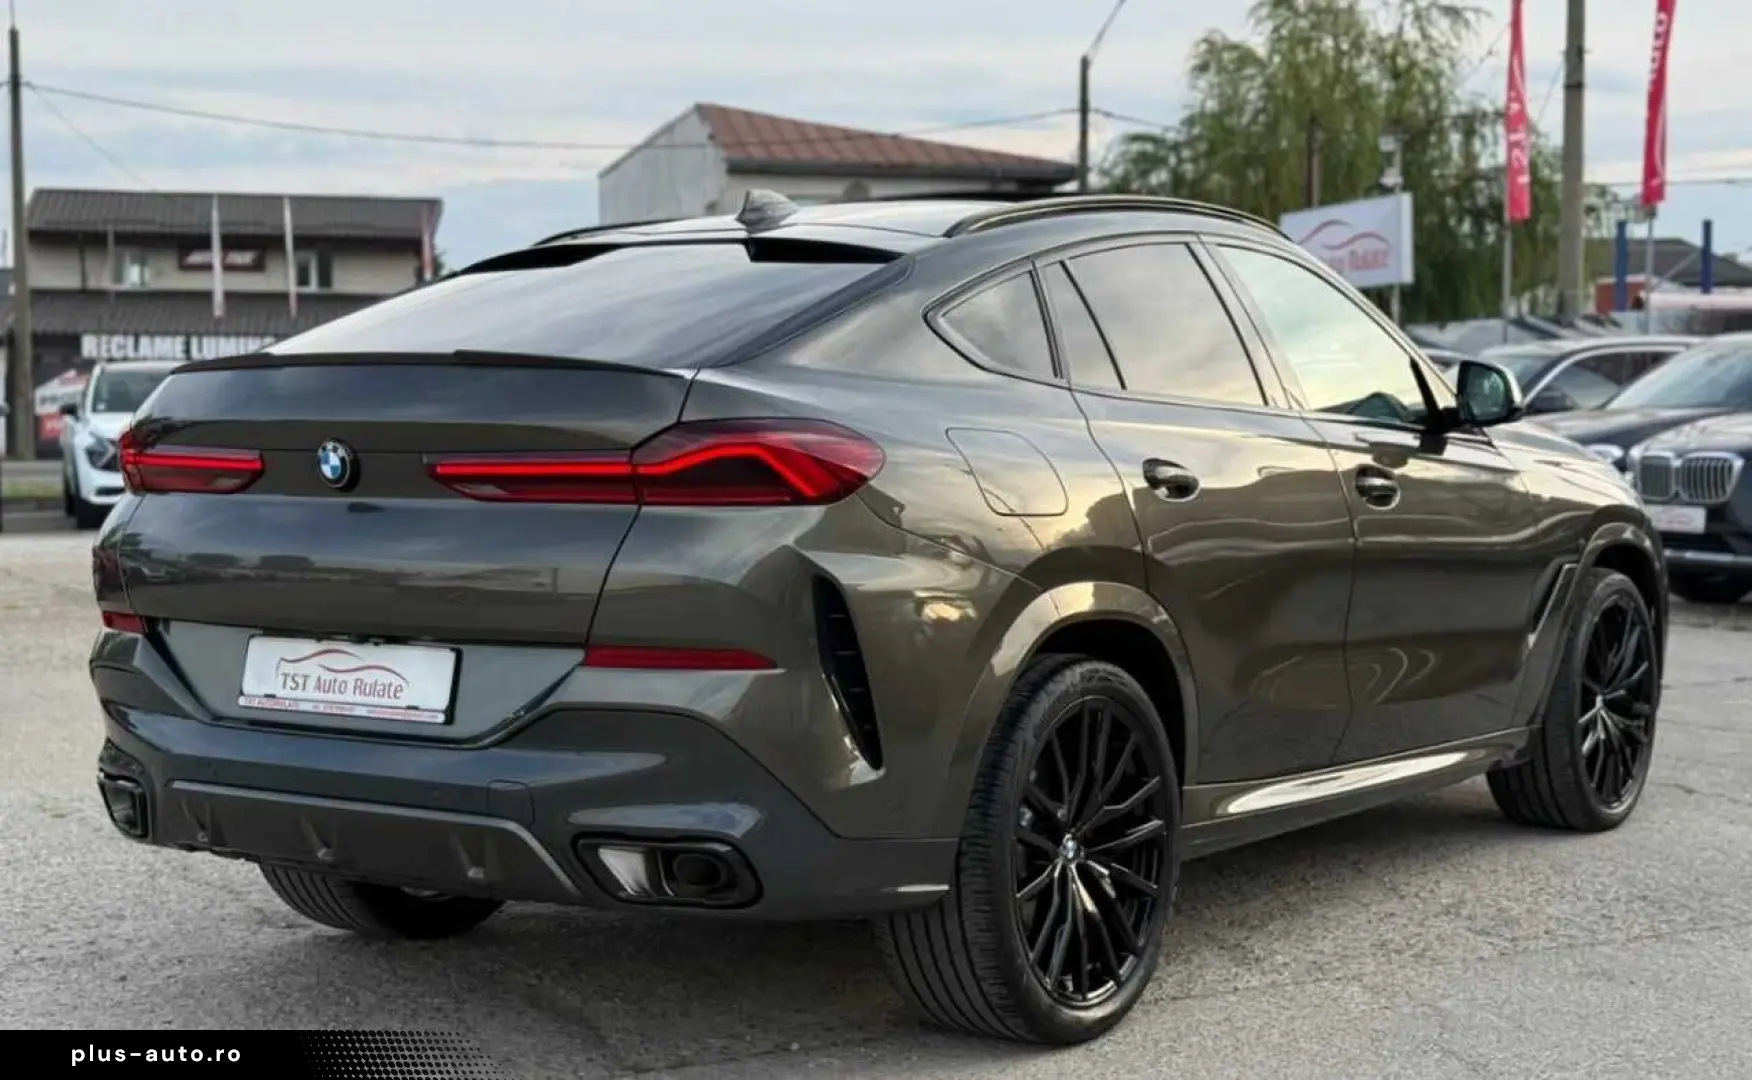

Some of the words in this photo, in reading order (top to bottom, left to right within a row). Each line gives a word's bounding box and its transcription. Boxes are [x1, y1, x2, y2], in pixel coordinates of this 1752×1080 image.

[81, 334, 187, 360] RECLAME
[280, 672, 311, 692] TST
[313, 677, 350, 695] Auto
[352, 678, 405, 700] Rulate
